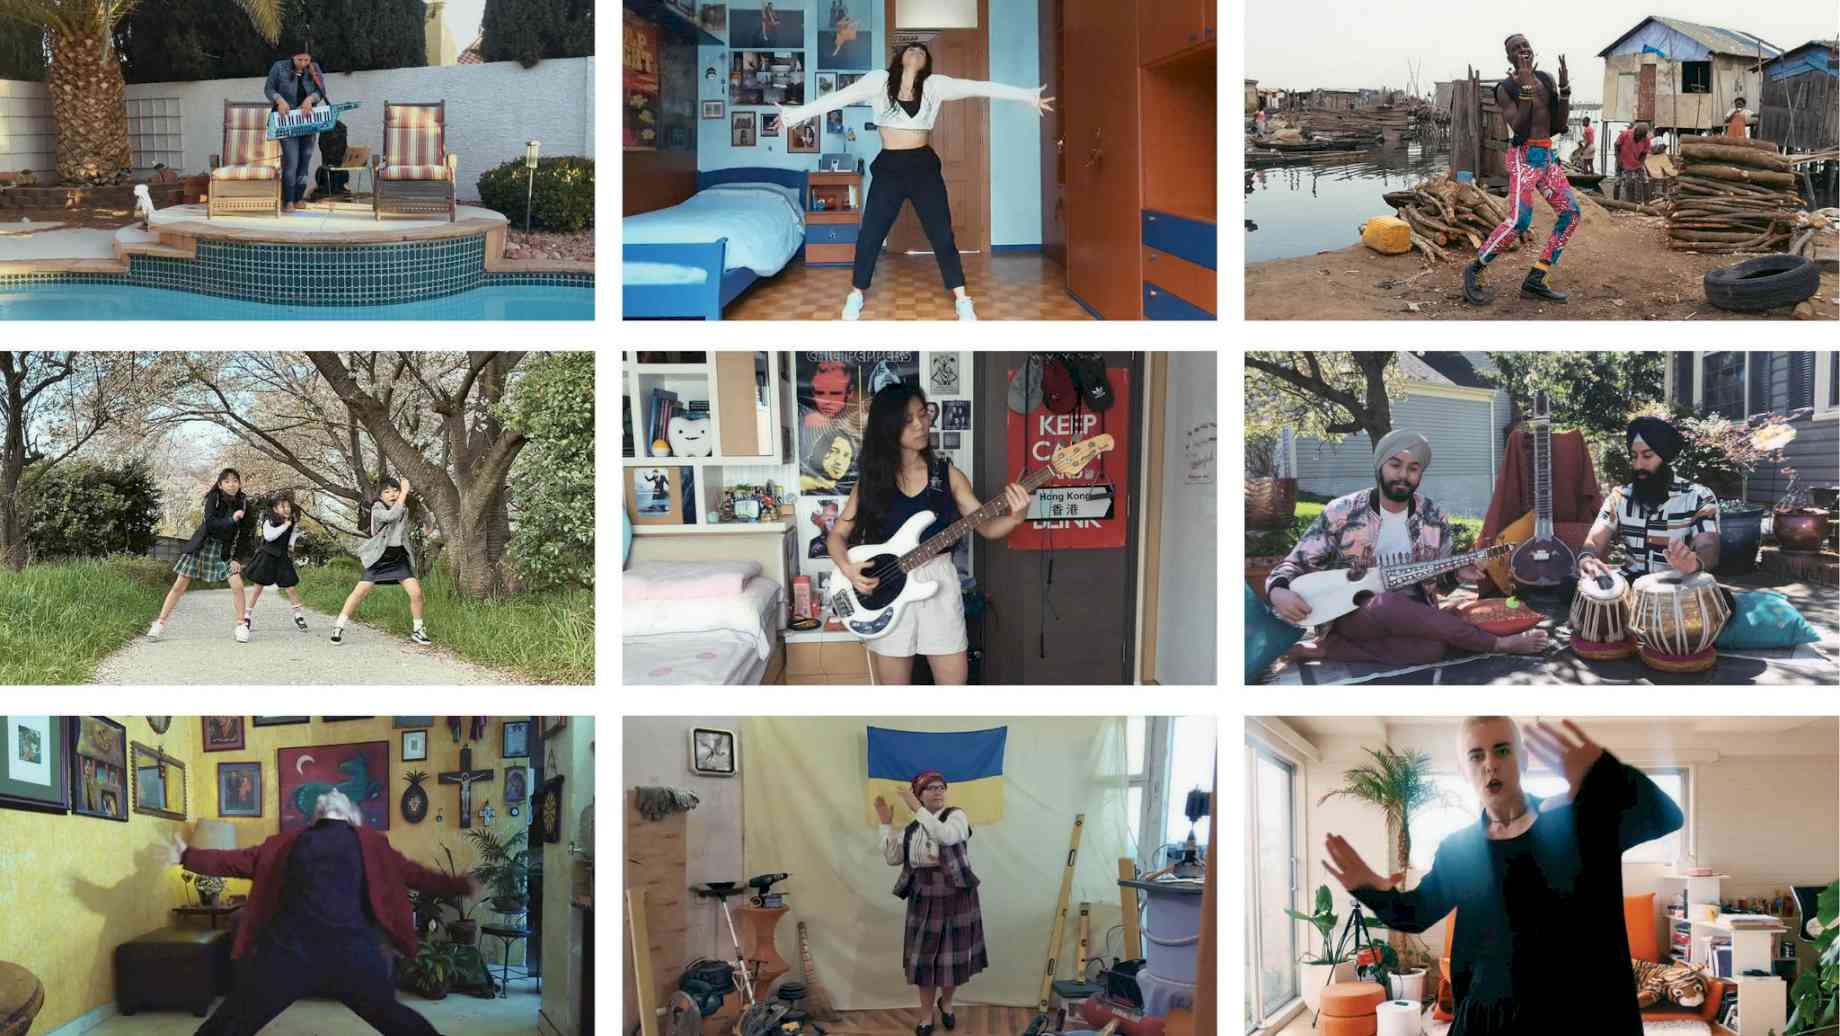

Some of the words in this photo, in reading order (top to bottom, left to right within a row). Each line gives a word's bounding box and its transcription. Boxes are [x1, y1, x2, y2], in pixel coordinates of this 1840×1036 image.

[1040, 415, 1097, 435] KEEP
[1040, 492, 1064, 502] Hong
[1053, 504, 1079, 516] 香港
